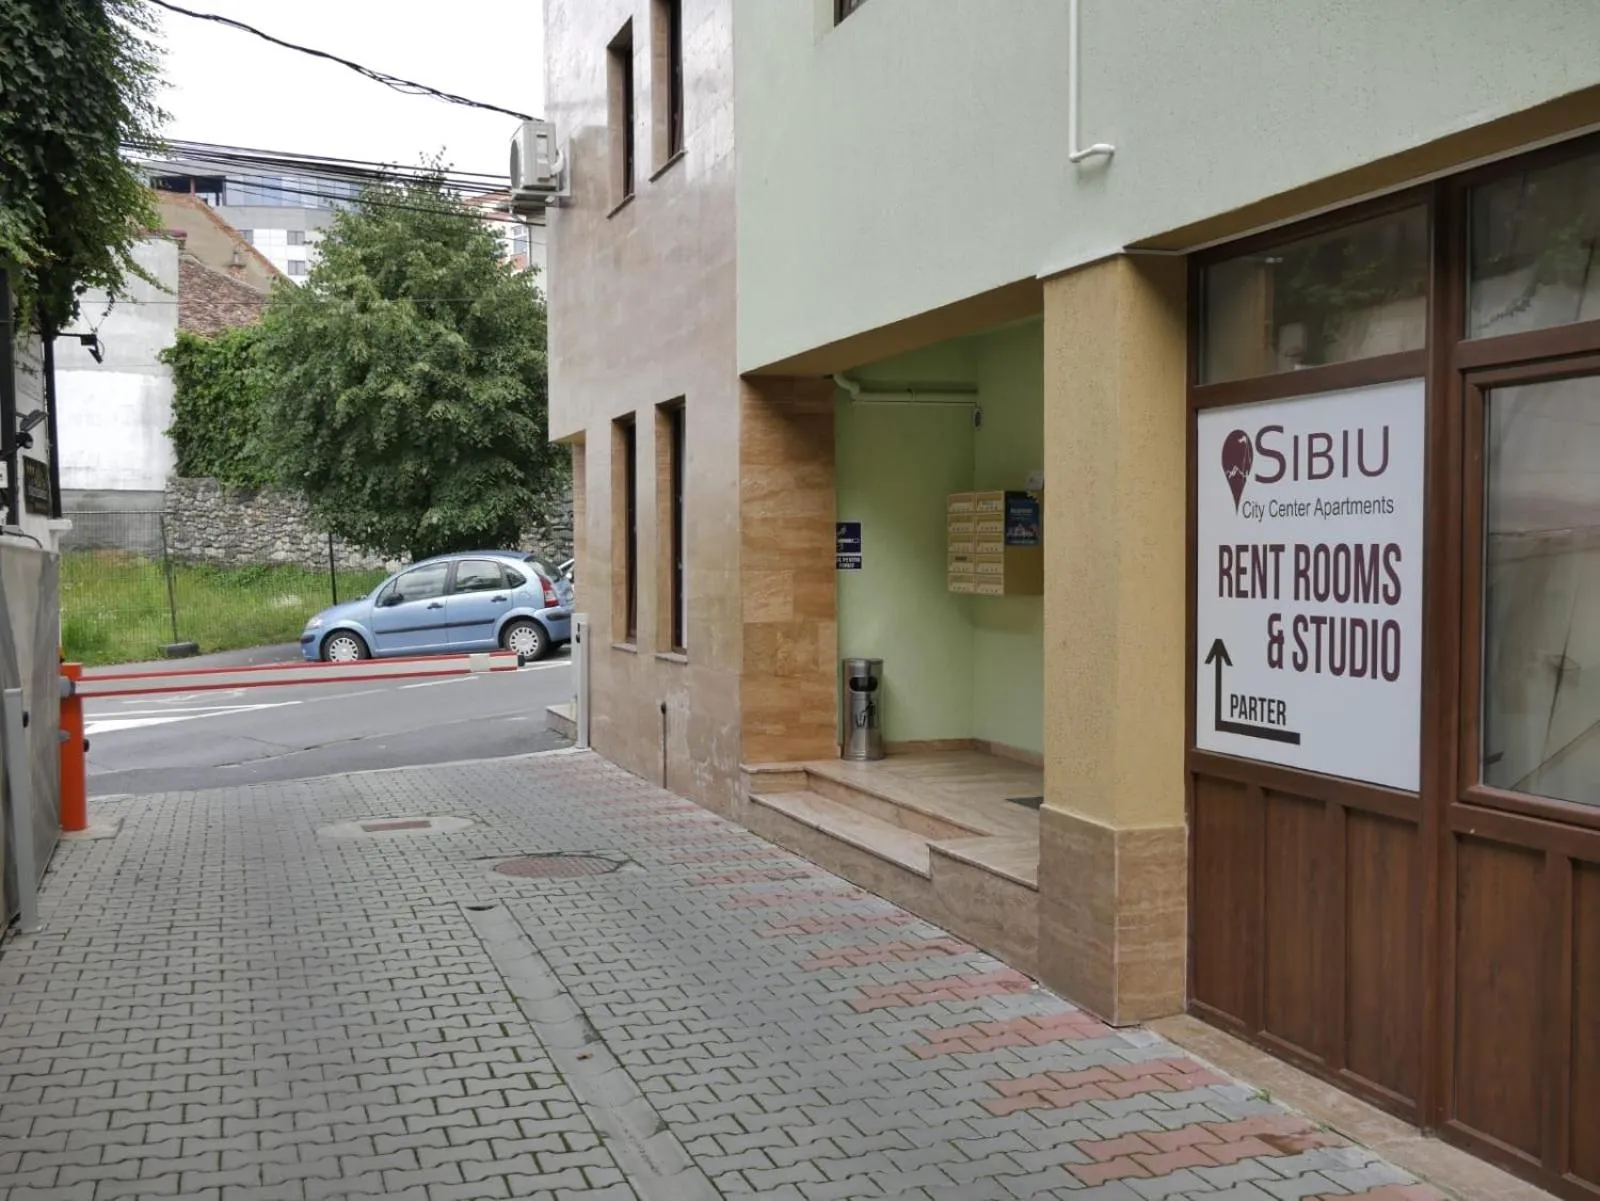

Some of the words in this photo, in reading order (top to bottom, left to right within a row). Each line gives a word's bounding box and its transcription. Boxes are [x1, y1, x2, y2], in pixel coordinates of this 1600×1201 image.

[1255, 425, 1390, 484] SIBIU
[1243, 500, 1265, 523] City
[1269, 499, 1312, 518] Center
[1314, 496, 1395, 521] Apartments
[1219, 544, 1286, 601] RENT
[1294, 543, 1402, 606] ROOMS
[1267, 613, 1285, 670] &
[1292, 614, 1401, 683] STUDIO
[1229, 694, 1287, 726] PARTER
